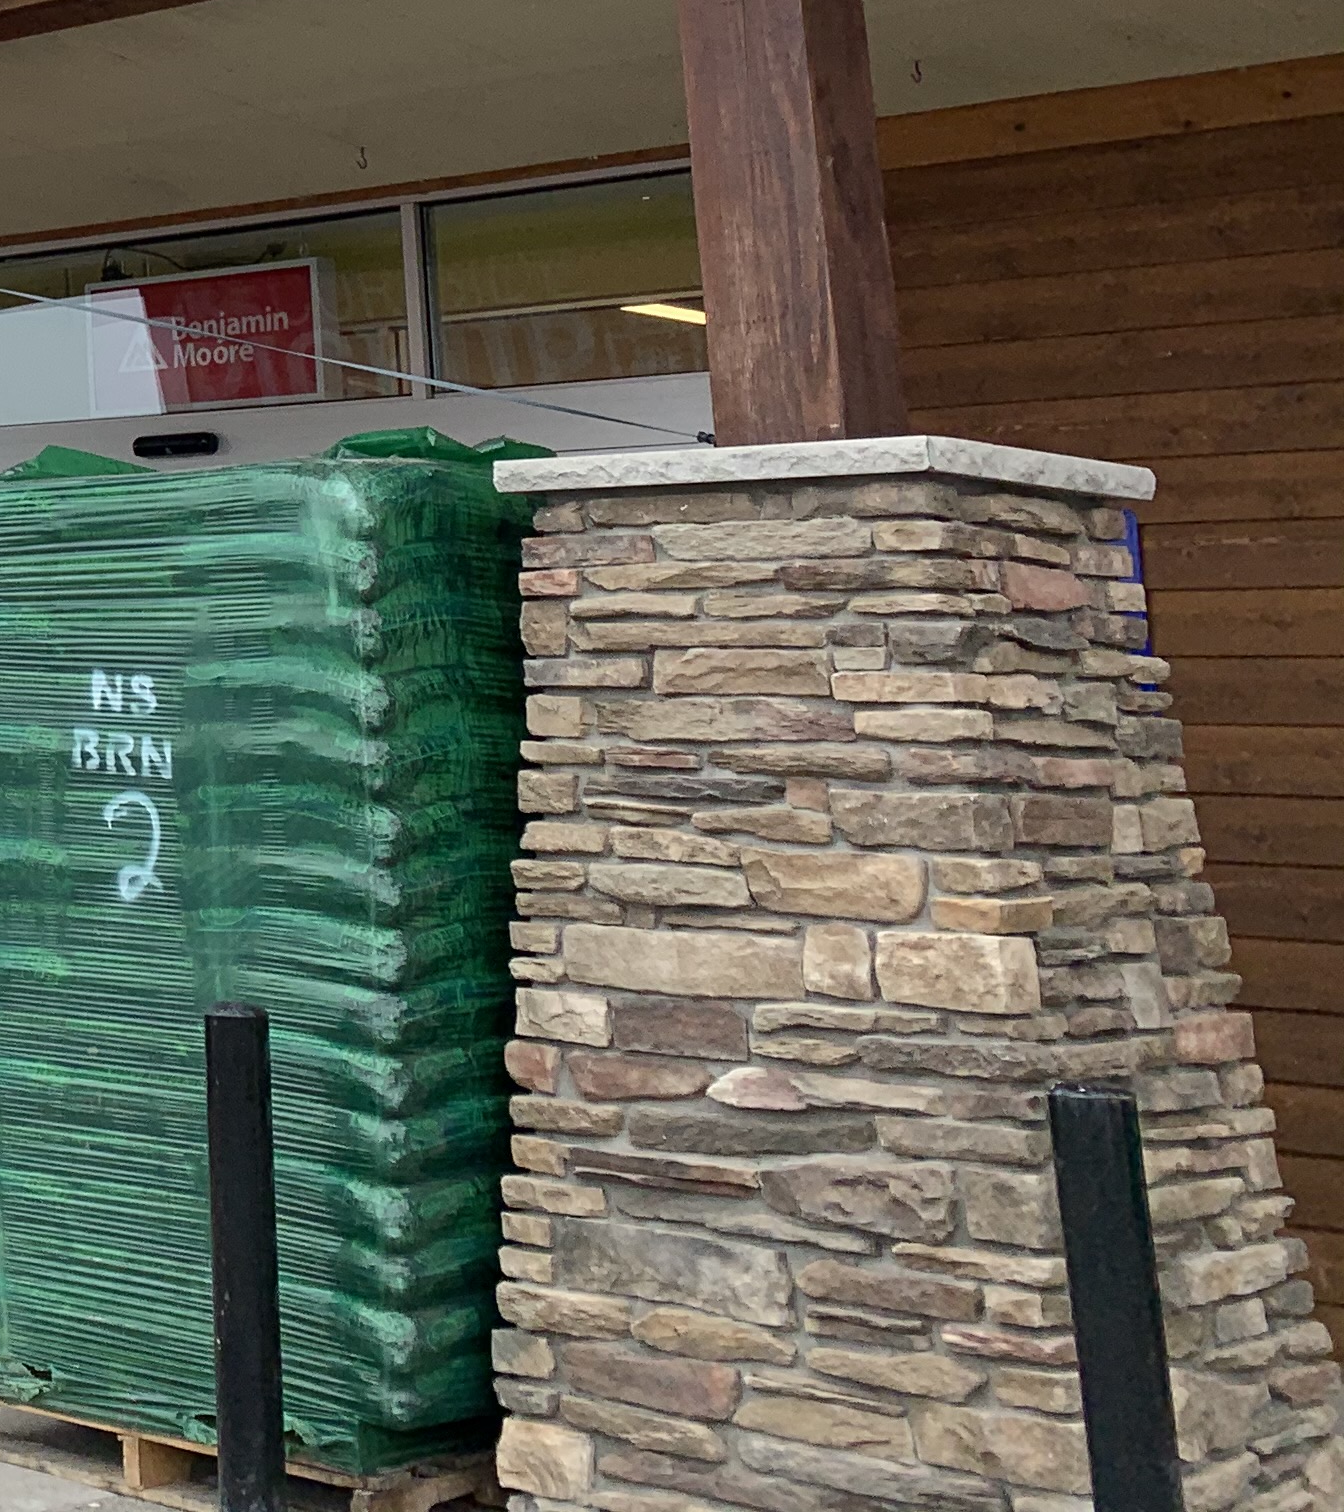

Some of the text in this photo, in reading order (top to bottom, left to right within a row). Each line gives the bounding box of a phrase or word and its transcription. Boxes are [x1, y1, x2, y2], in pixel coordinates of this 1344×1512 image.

[171, 306, 290, 344] Benjamin
[172, 342, 255, 369] Moore
[91, 669, 158, 715] NS
[72, 727, 173, 779] BRN
